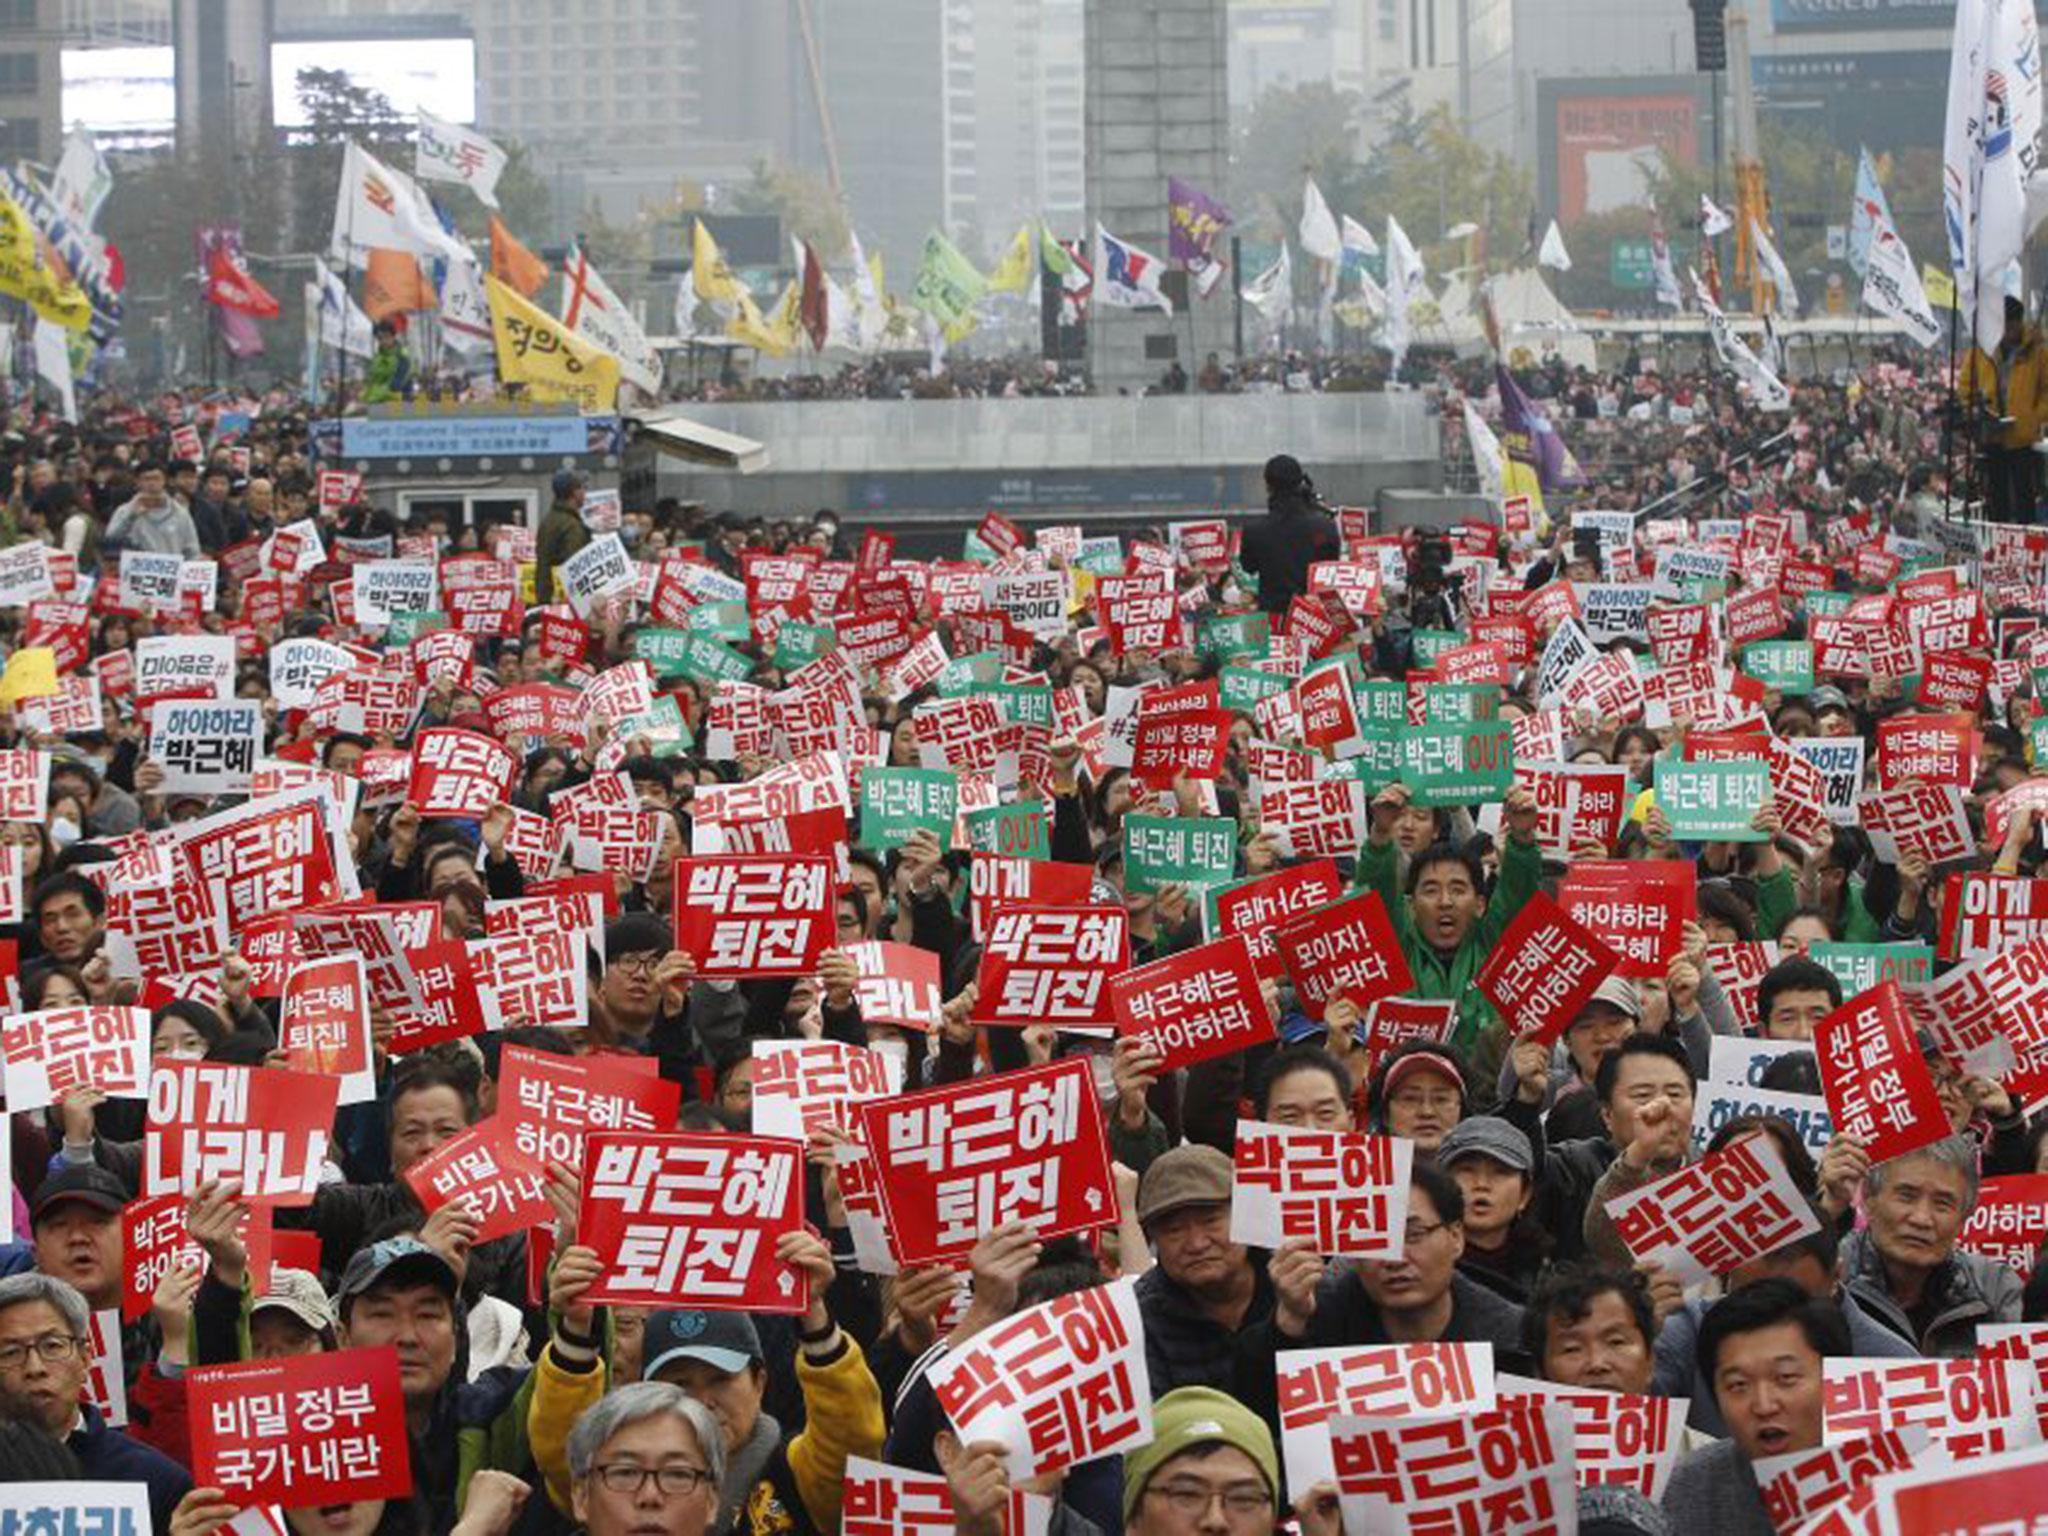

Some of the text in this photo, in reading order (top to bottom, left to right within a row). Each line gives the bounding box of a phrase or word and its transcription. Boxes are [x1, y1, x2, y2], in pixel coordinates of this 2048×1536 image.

[128, 575, 177, 598] 박근혜
[368, 571, 433, 589] 하야하라
[368, 590, 430, 613] 박근혜
[452, 589, 514, 613] 박근혜
[1586, 588, 1651, 607] 하야하라
[461, 612, 503, 634] 퇴진
[1111, 596, 1174, 625] 박근혜
[1648, 610, 1704, 638] 박근혜
[1908, 595, 1977, 629] 박근혜
[414, 632, 474, 659] 박근혜
[1123, 625, 1165, 651] 퇴진
[345, 678, 418, 710] 박근혜
[1596, 673, 1642, 718] 퇴진
[1642, 663, 1716, 701] 박근혜
[166, 708, 255, 736] 하야하라
[914, 700, 1001, 745] 박근혜
[1018, 693, 1050, 721] 퇴진
[1373, 690, 1403, 721] 퇴진
[1430, 691, 1473, 723] 박근혜
[165, 740, 255, 775] 박근혜
[1180, 724, 1218, 746] 정부
[1406, 731, 1511, 776] 박근혜 OUT
[1884, 729, 1961, 753] 박근혜는
[419, 733, 513, 788] 박근혜
[1178, 747, 1215, 769] 내란
[1885, 753, 1960, 778] 하야하라
[428, 772, 499, 813] 퇴진
[694, 780, 802, 821] 박근혜
[867, 776, 957, 822] 박근혜 퇴진
[1261, 780, 1354, 825] 박근혜
[1661, 773, 1764, 811] 박근혜 퇴진
[1859, 784, 1955, 834] 박근혜
[200, 812, 314, 880] 박근혜
[577, 810, 661, 844] 박근혜
[1000, 811, 1040, 852] OUT
[1129, 826, 1230, 869] 박근혜 퇴진
[1288, 820, 1356, 857] 퇴진
[601, 845, 655, 880] 퇴진
[970, 856, 1032, 899] 이게
[106, 878, 218, 937] 박근혜
[230, 862, 304, 924] 퇴진
[686, 861, 828, 916] 박근혜
[1964, 877, 2032, 916] 이게
[485, 893, 595, 940] 박근혜
[988, 912, 1124, 964] 박근혜
[1569, 901, 1669, 932] 하야하라
[135, 925, 222, 978] 퇴진
[469, 935, 576, 987] 박근혜
[704, 917, 812, 970] 퇴진
[1294, 918, 1373, 970] 모이자!
[286, 983, 355, 1021] 박근혜
[499, 976, 580, 1027] 퇴진
[995, 967, 1105, 1019] 퇴진
[1128, 964, 1239, 1022] 박근혜는
[2, 1006, 138, 1067] 박근혜
[288, 1020, 349, 1053] 퇴진!
[1140, 997, 1254, 1060] 하야하라
[752, 1042, 890, 1100] 박근혜
[148, 1066, 251, 1125] 이게
[518, 1075, 657, 1131] 박근혜는
[887, 1072, 1082, 1174] 박근혜
[432, 1145, 500, 1197] 비밀
[589, 1144, 795, 1221] 박근혜
[1233, 1133, 1396, 1195] 박근혜
[935, 1155, 1062, 1248] 퇴진
[1614, 1129, 1772, 1257] 박근혜
[1281, 1193, 1390, 1255] 퇴진
[1685, 1191, 1806, 1276] 퇴진
[605, 1223, 761, 1298] 퇴진
[933, 1282, 1131, 1430] 박근혜
[1275, 1342, 1477, 1431] 박근혜
[1822, 1357, 2012, 1434] 박근혜
[211, 1382, 378, 1441] 비밀 정부
[1022, 1359, 1142, 1476] 퇴진
[214, 1432, 383, 1492] 국가 내란
[1329, 1405, 1557, 1505] 박근혜
